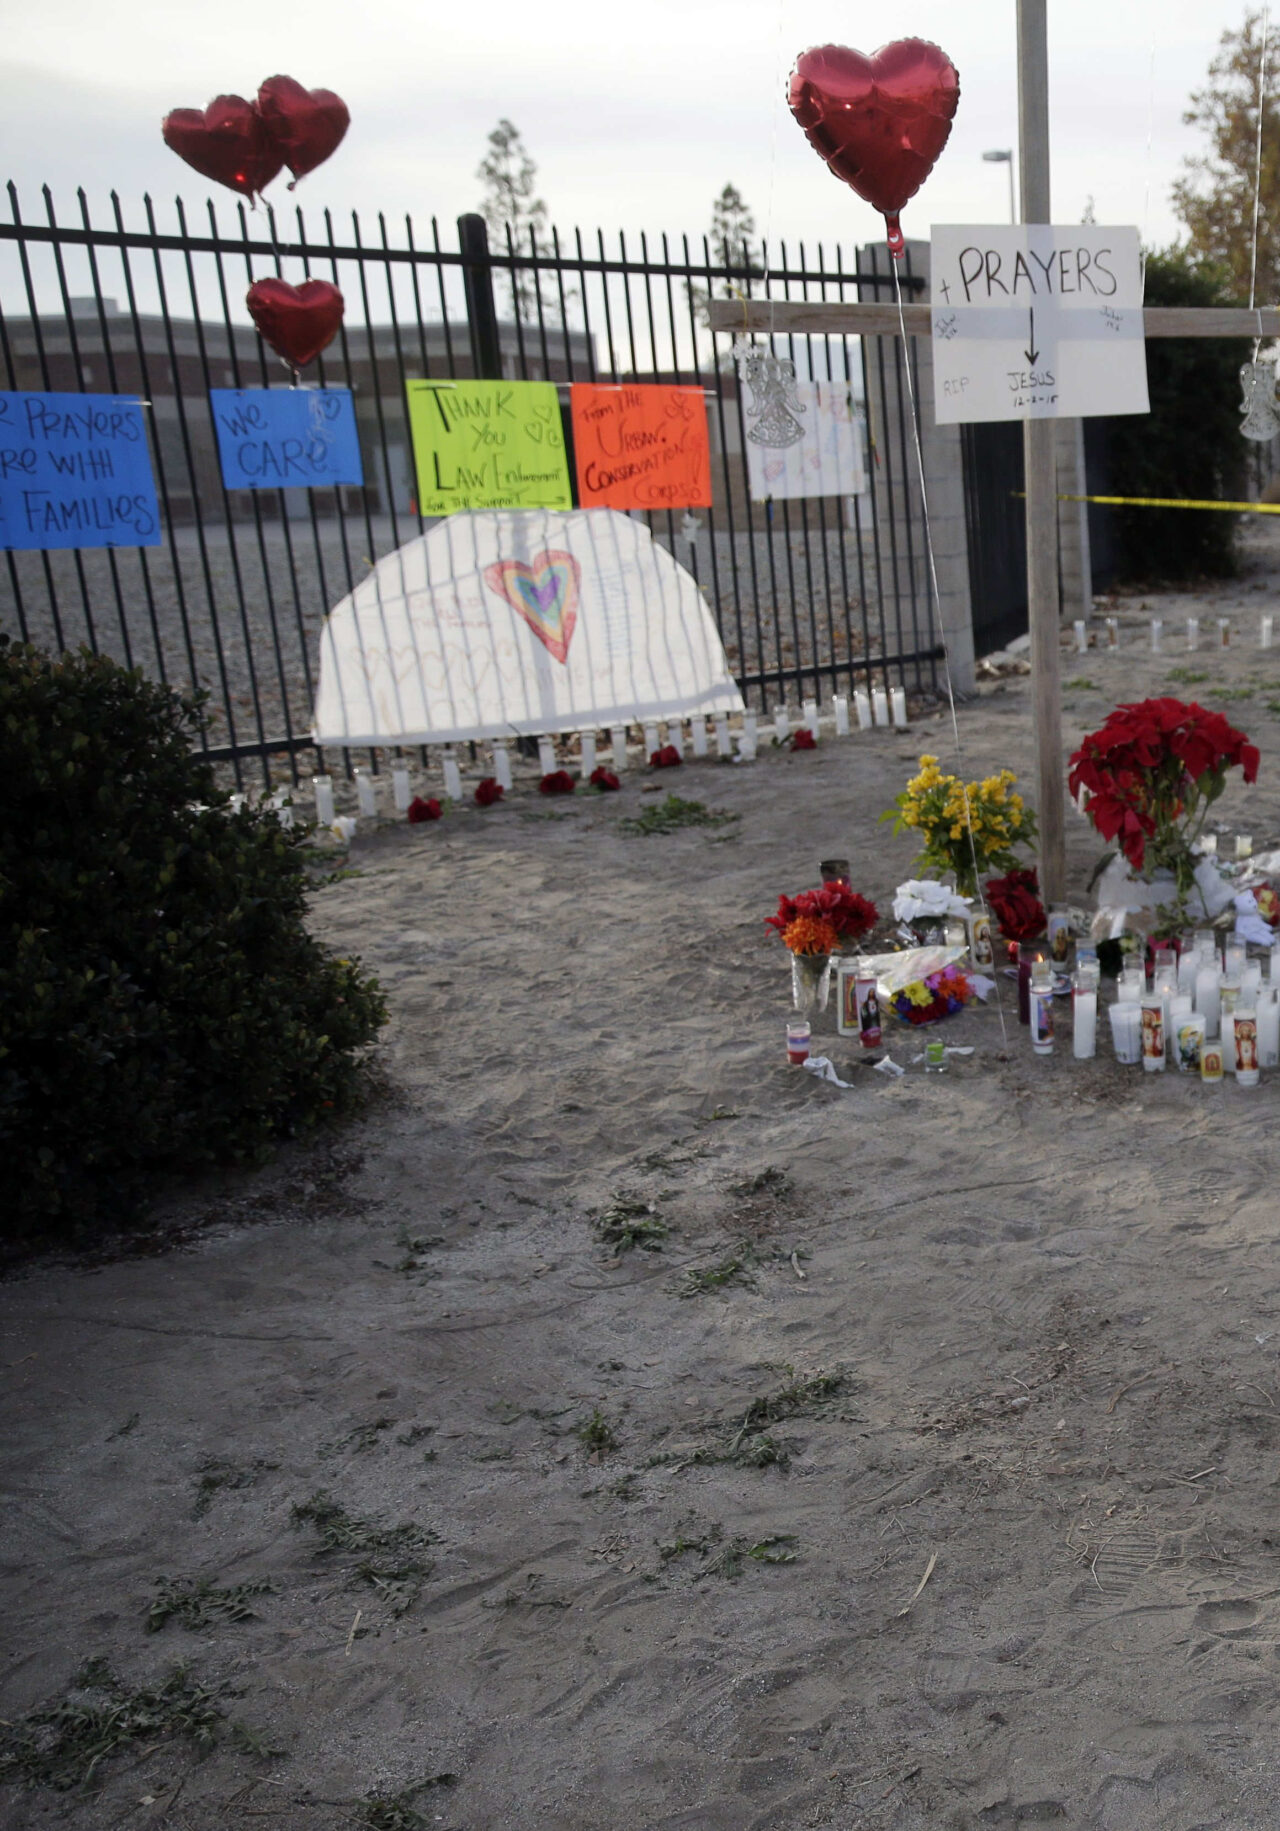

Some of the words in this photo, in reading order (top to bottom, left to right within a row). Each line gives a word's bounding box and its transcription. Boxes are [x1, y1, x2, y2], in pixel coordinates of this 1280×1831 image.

[959, 246, 1117, 303] PRAYERS
[1007, 371, 1055, 391] JESUS
[414, 383, 517, 433] THANK
